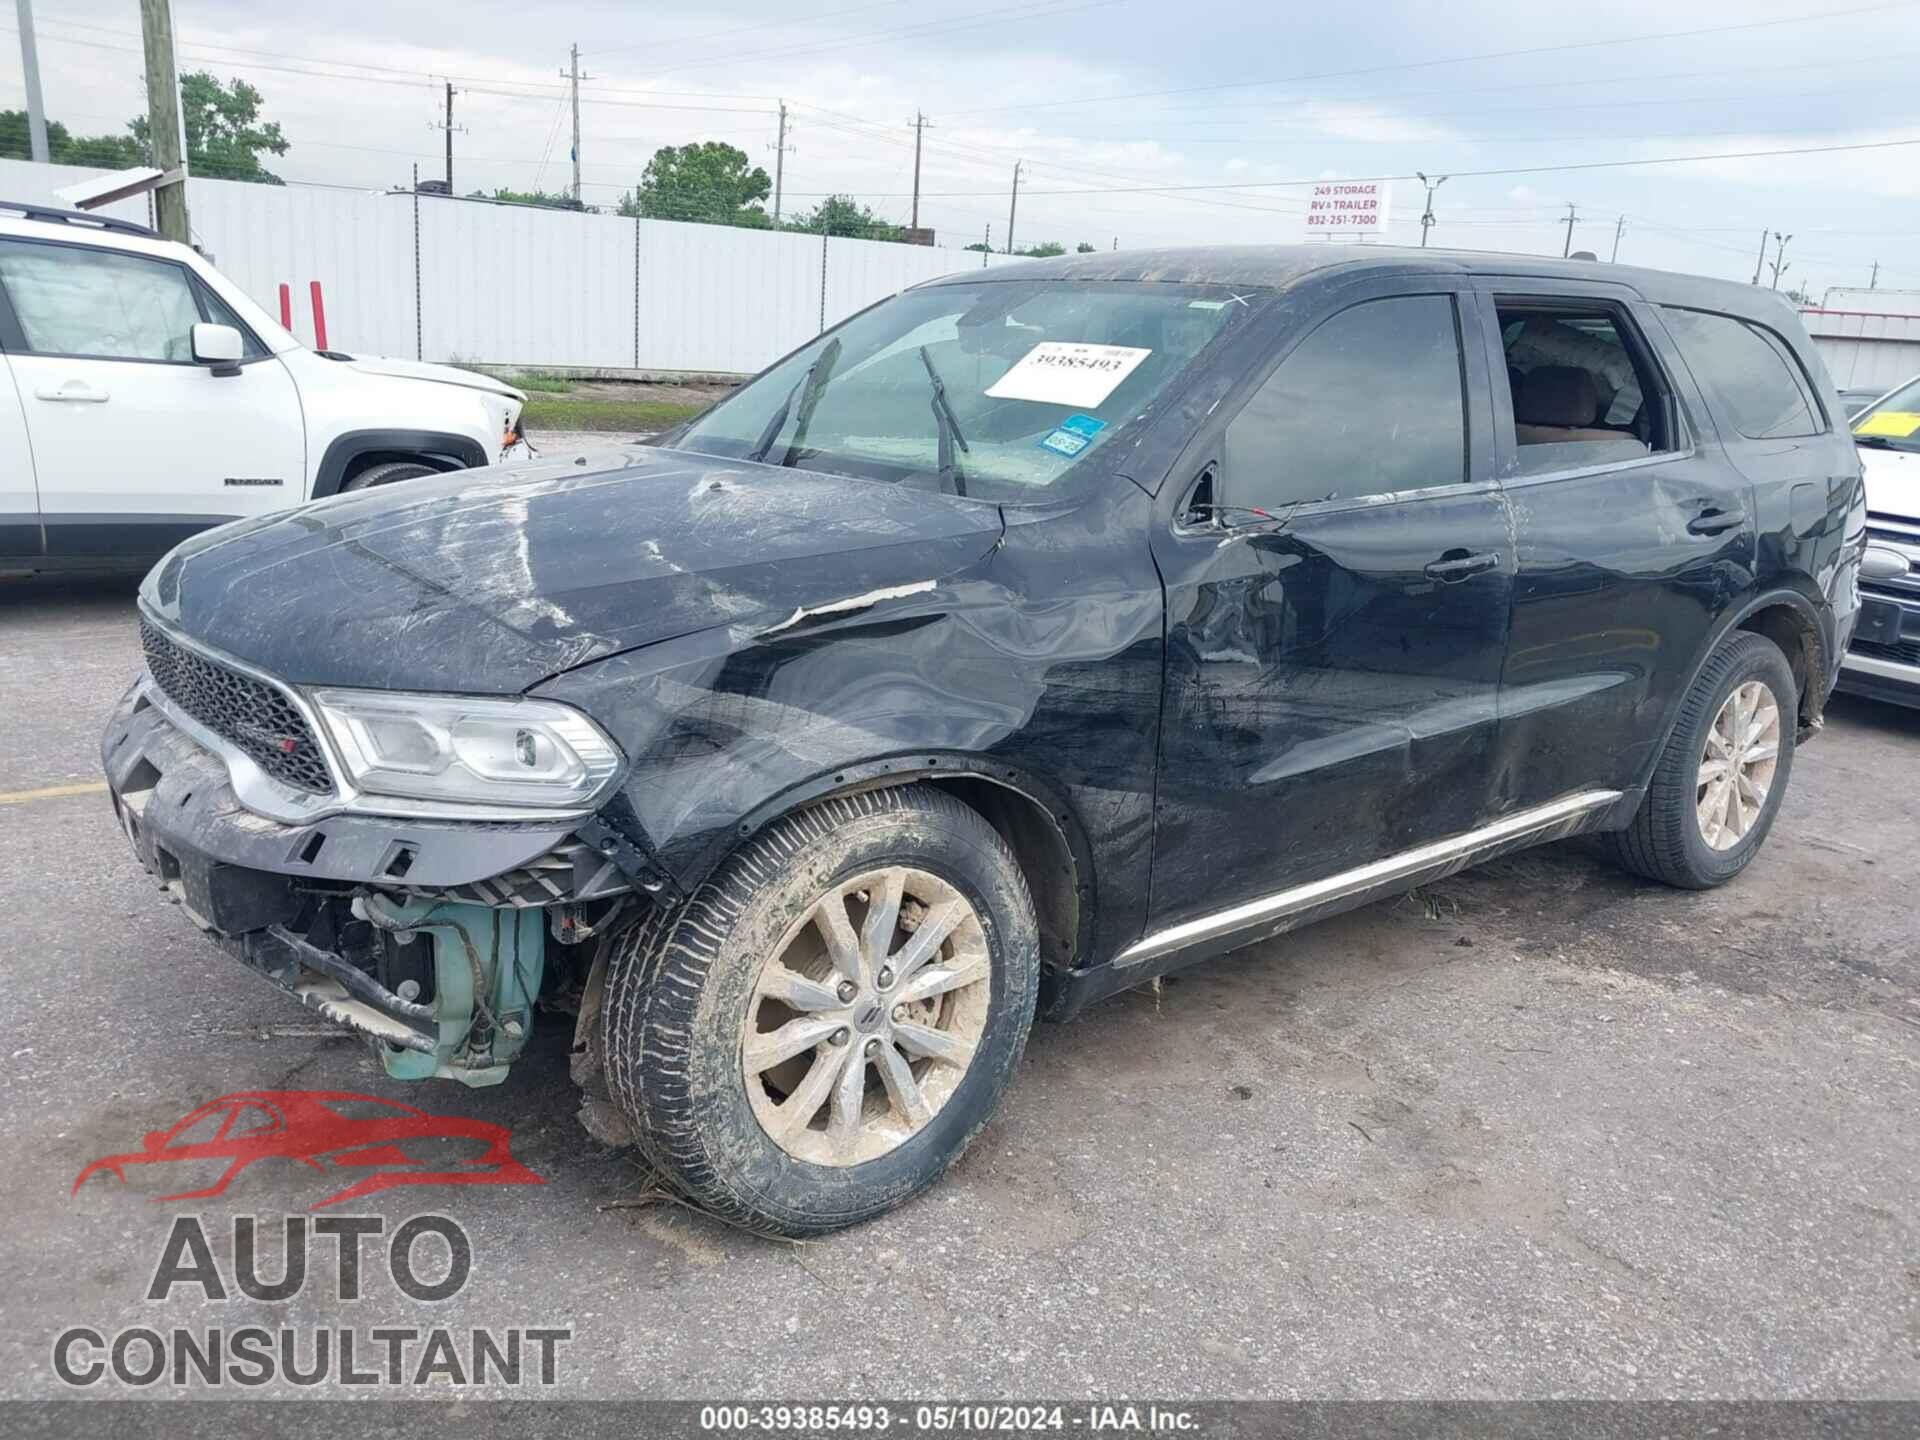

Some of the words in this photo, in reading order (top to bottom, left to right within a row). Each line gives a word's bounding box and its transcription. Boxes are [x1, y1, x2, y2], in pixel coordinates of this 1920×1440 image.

[1314, 187, 1332, 196] 249
[1334, 185, 1377, 195] STORAGE
[1311, 201, 1326, 210] RV
[1334, 200, 1377, 210] TRAILER
[1308, 215, 1377, 225] 832-251-7300
[1030, 354, 1123, 372] 39385493
